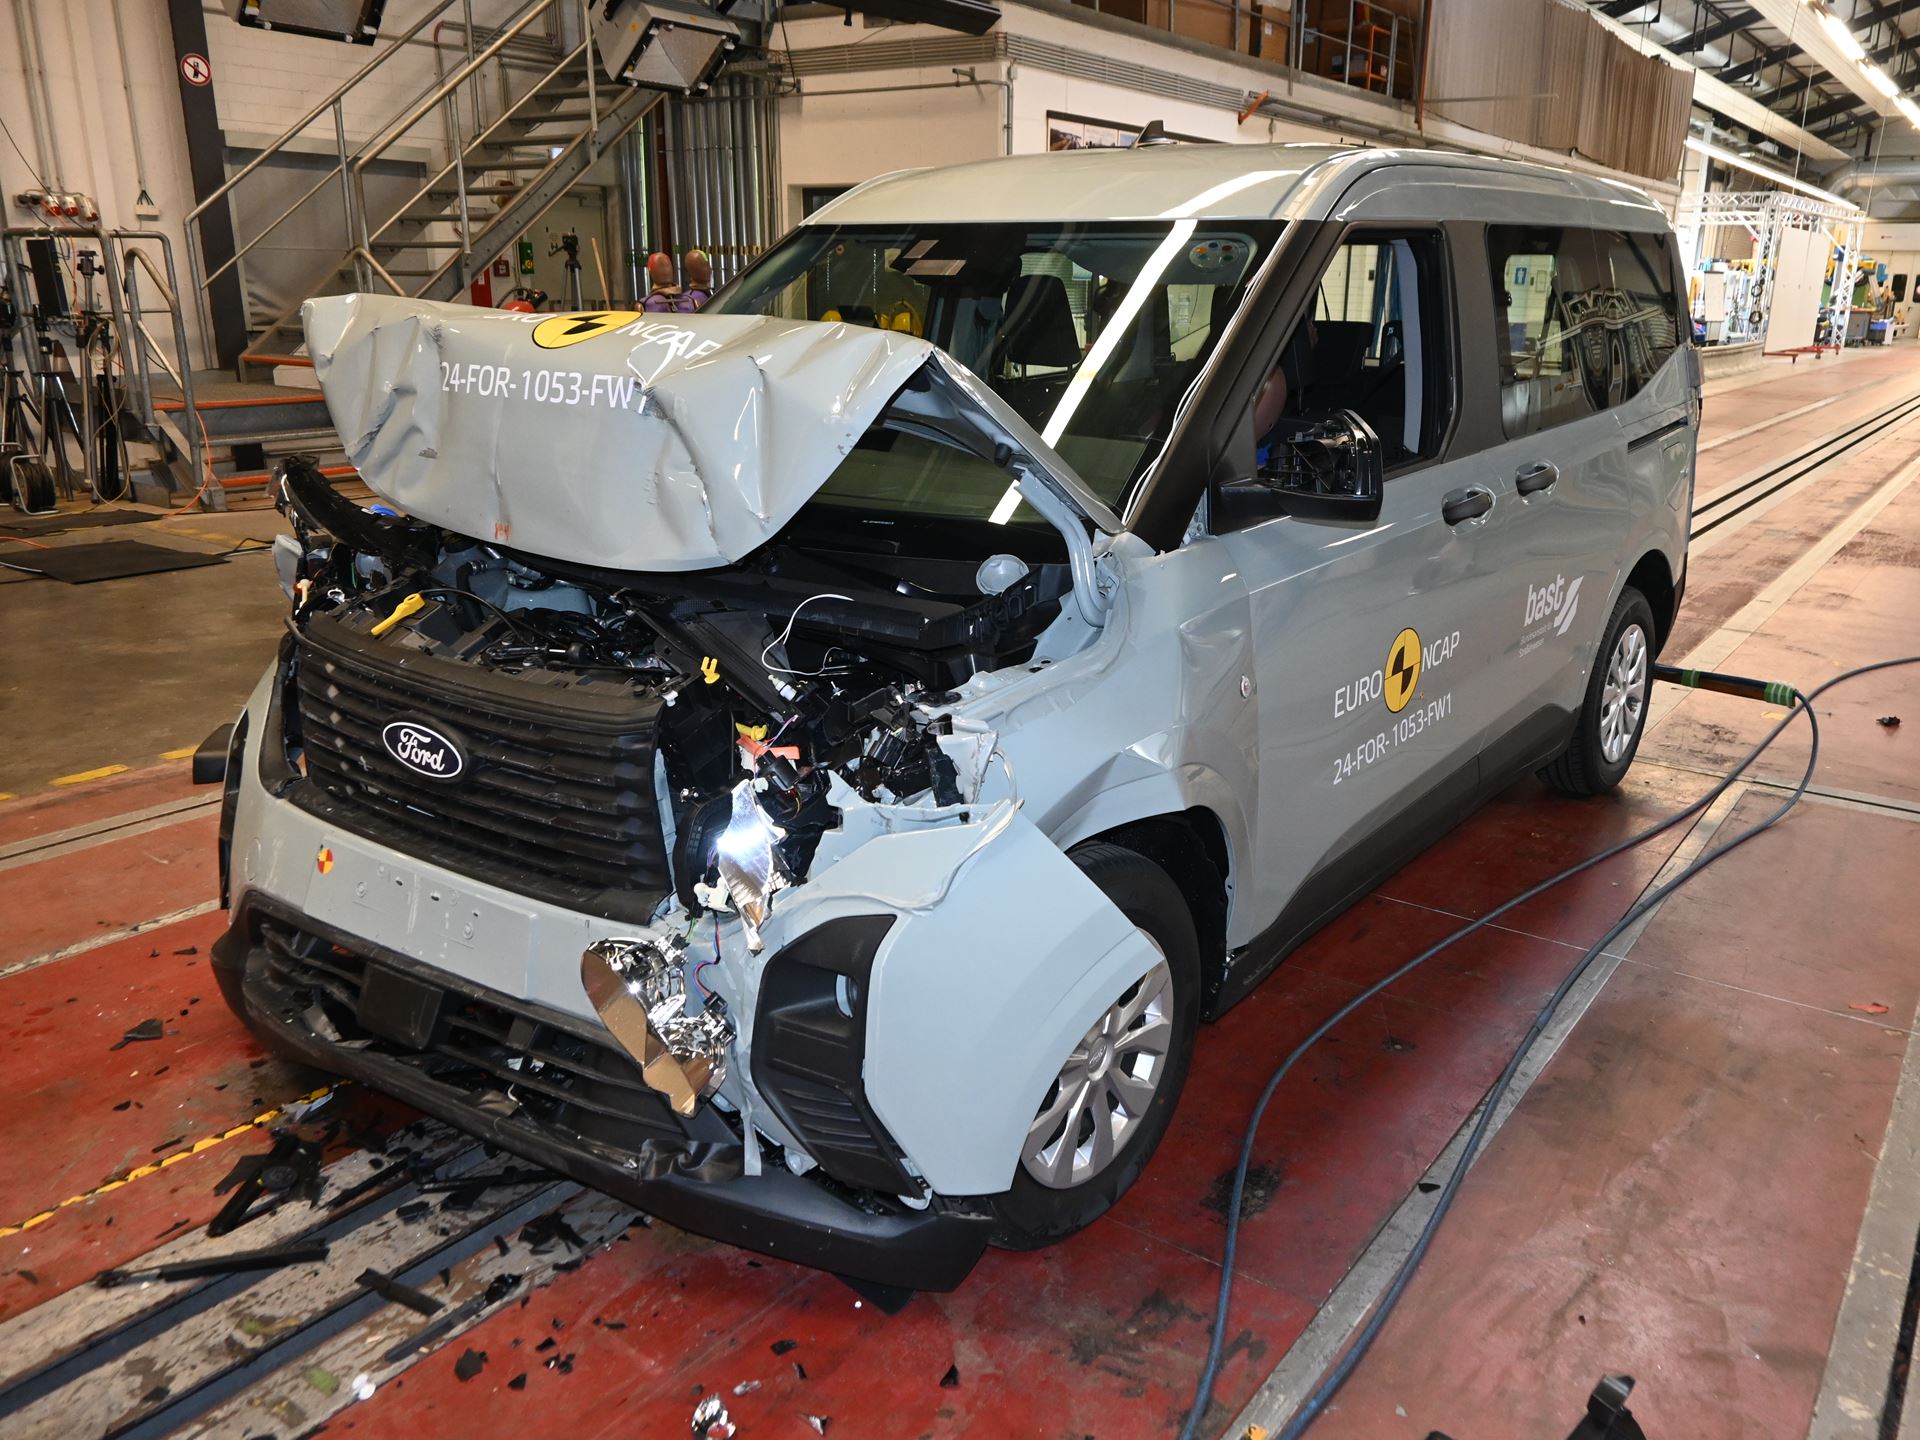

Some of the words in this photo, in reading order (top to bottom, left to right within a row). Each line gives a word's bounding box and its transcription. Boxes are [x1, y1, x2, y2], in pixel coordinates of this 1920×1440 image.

[1524, 573, 1565, 627] bast
[1333, 669, 1383, 719] EURO
[1421, 630, 1461, 673] NCAP
[397, 728, 446, 772] Ford
